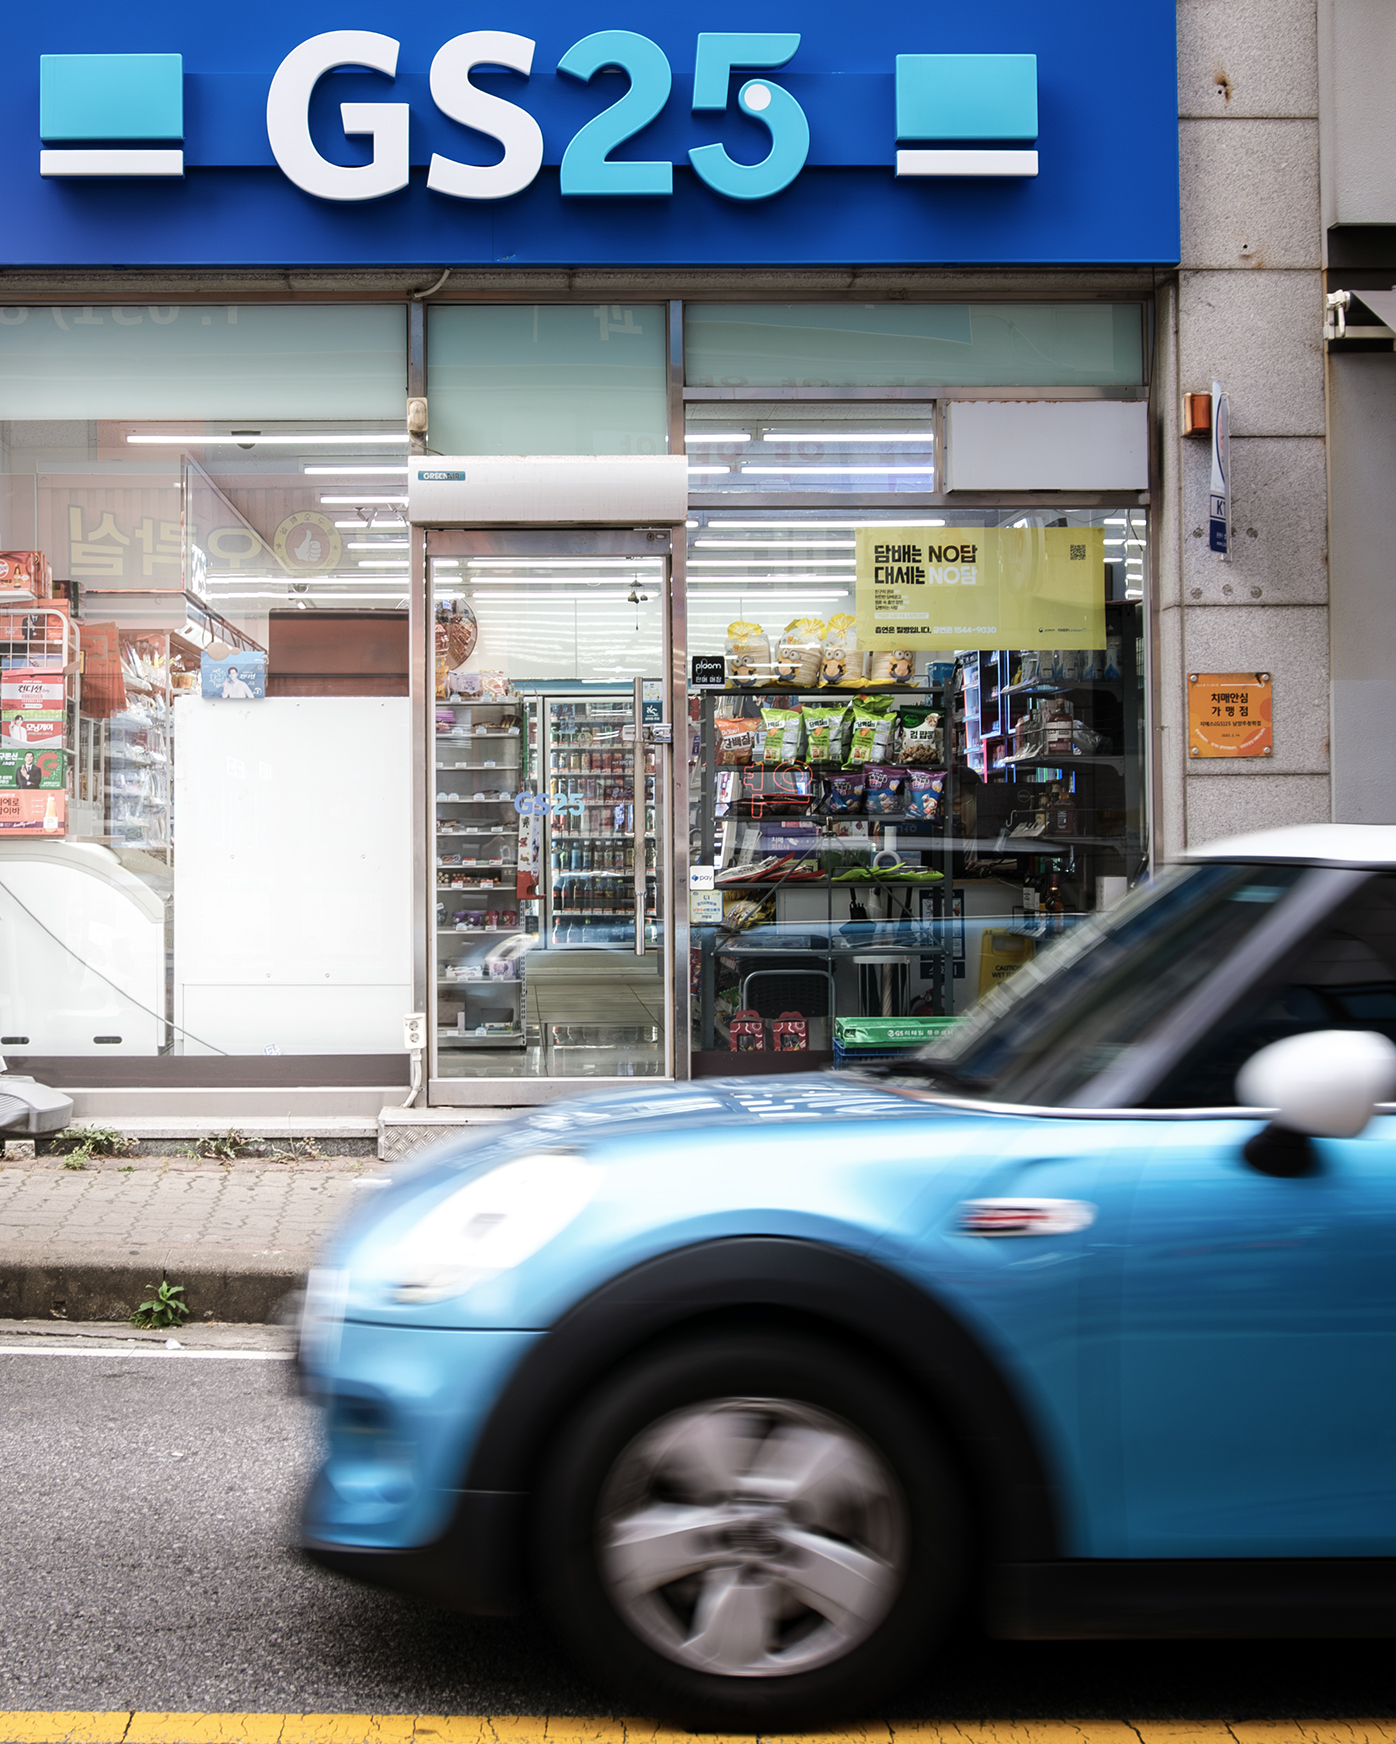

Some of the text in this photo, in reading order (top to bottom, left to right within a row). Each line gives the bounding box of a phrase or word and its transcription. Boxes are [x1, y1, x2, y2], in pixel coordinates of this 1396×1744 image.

[266, 29, 811, 201] GS25
[874, 544, 978, 563] 담배는 NO답
[874, 566, 978, 585] 대세는 NO담
[875, 626, 895, 634] 흡연은
[954, 626, 997, 634] 1544-9030
[695, 658, 722, 675] ploom
[1211, 692, 1249, 704] 치매안심
[514, 791, 585, 816] GS25
